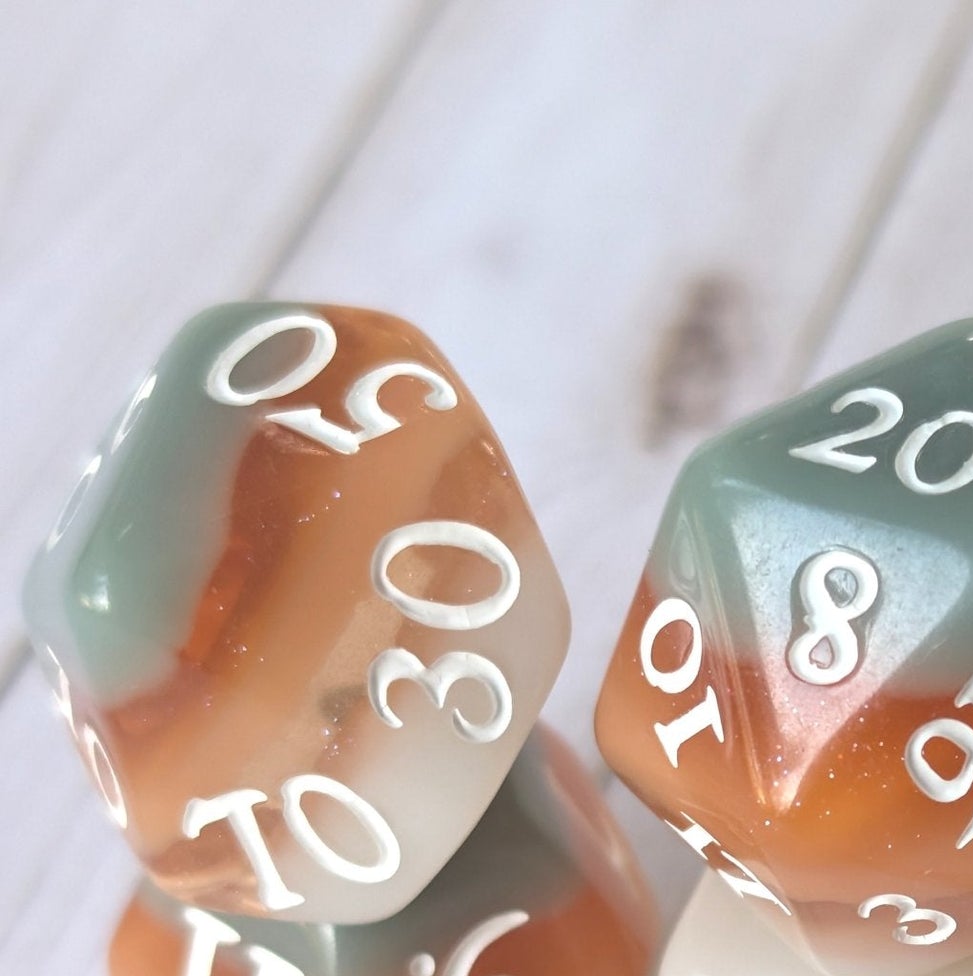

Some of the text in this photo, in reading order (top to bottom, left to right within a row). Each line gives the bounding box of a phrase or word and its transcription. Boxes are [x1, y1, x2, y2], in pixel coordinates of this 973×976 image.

[206, 315, 458, 454] 50
[369, 520, 520, 743] 30
[640, 598, 724, 767] 10
[787, 549, 879, 684] 8
[858, 894, 956, 945] 3
